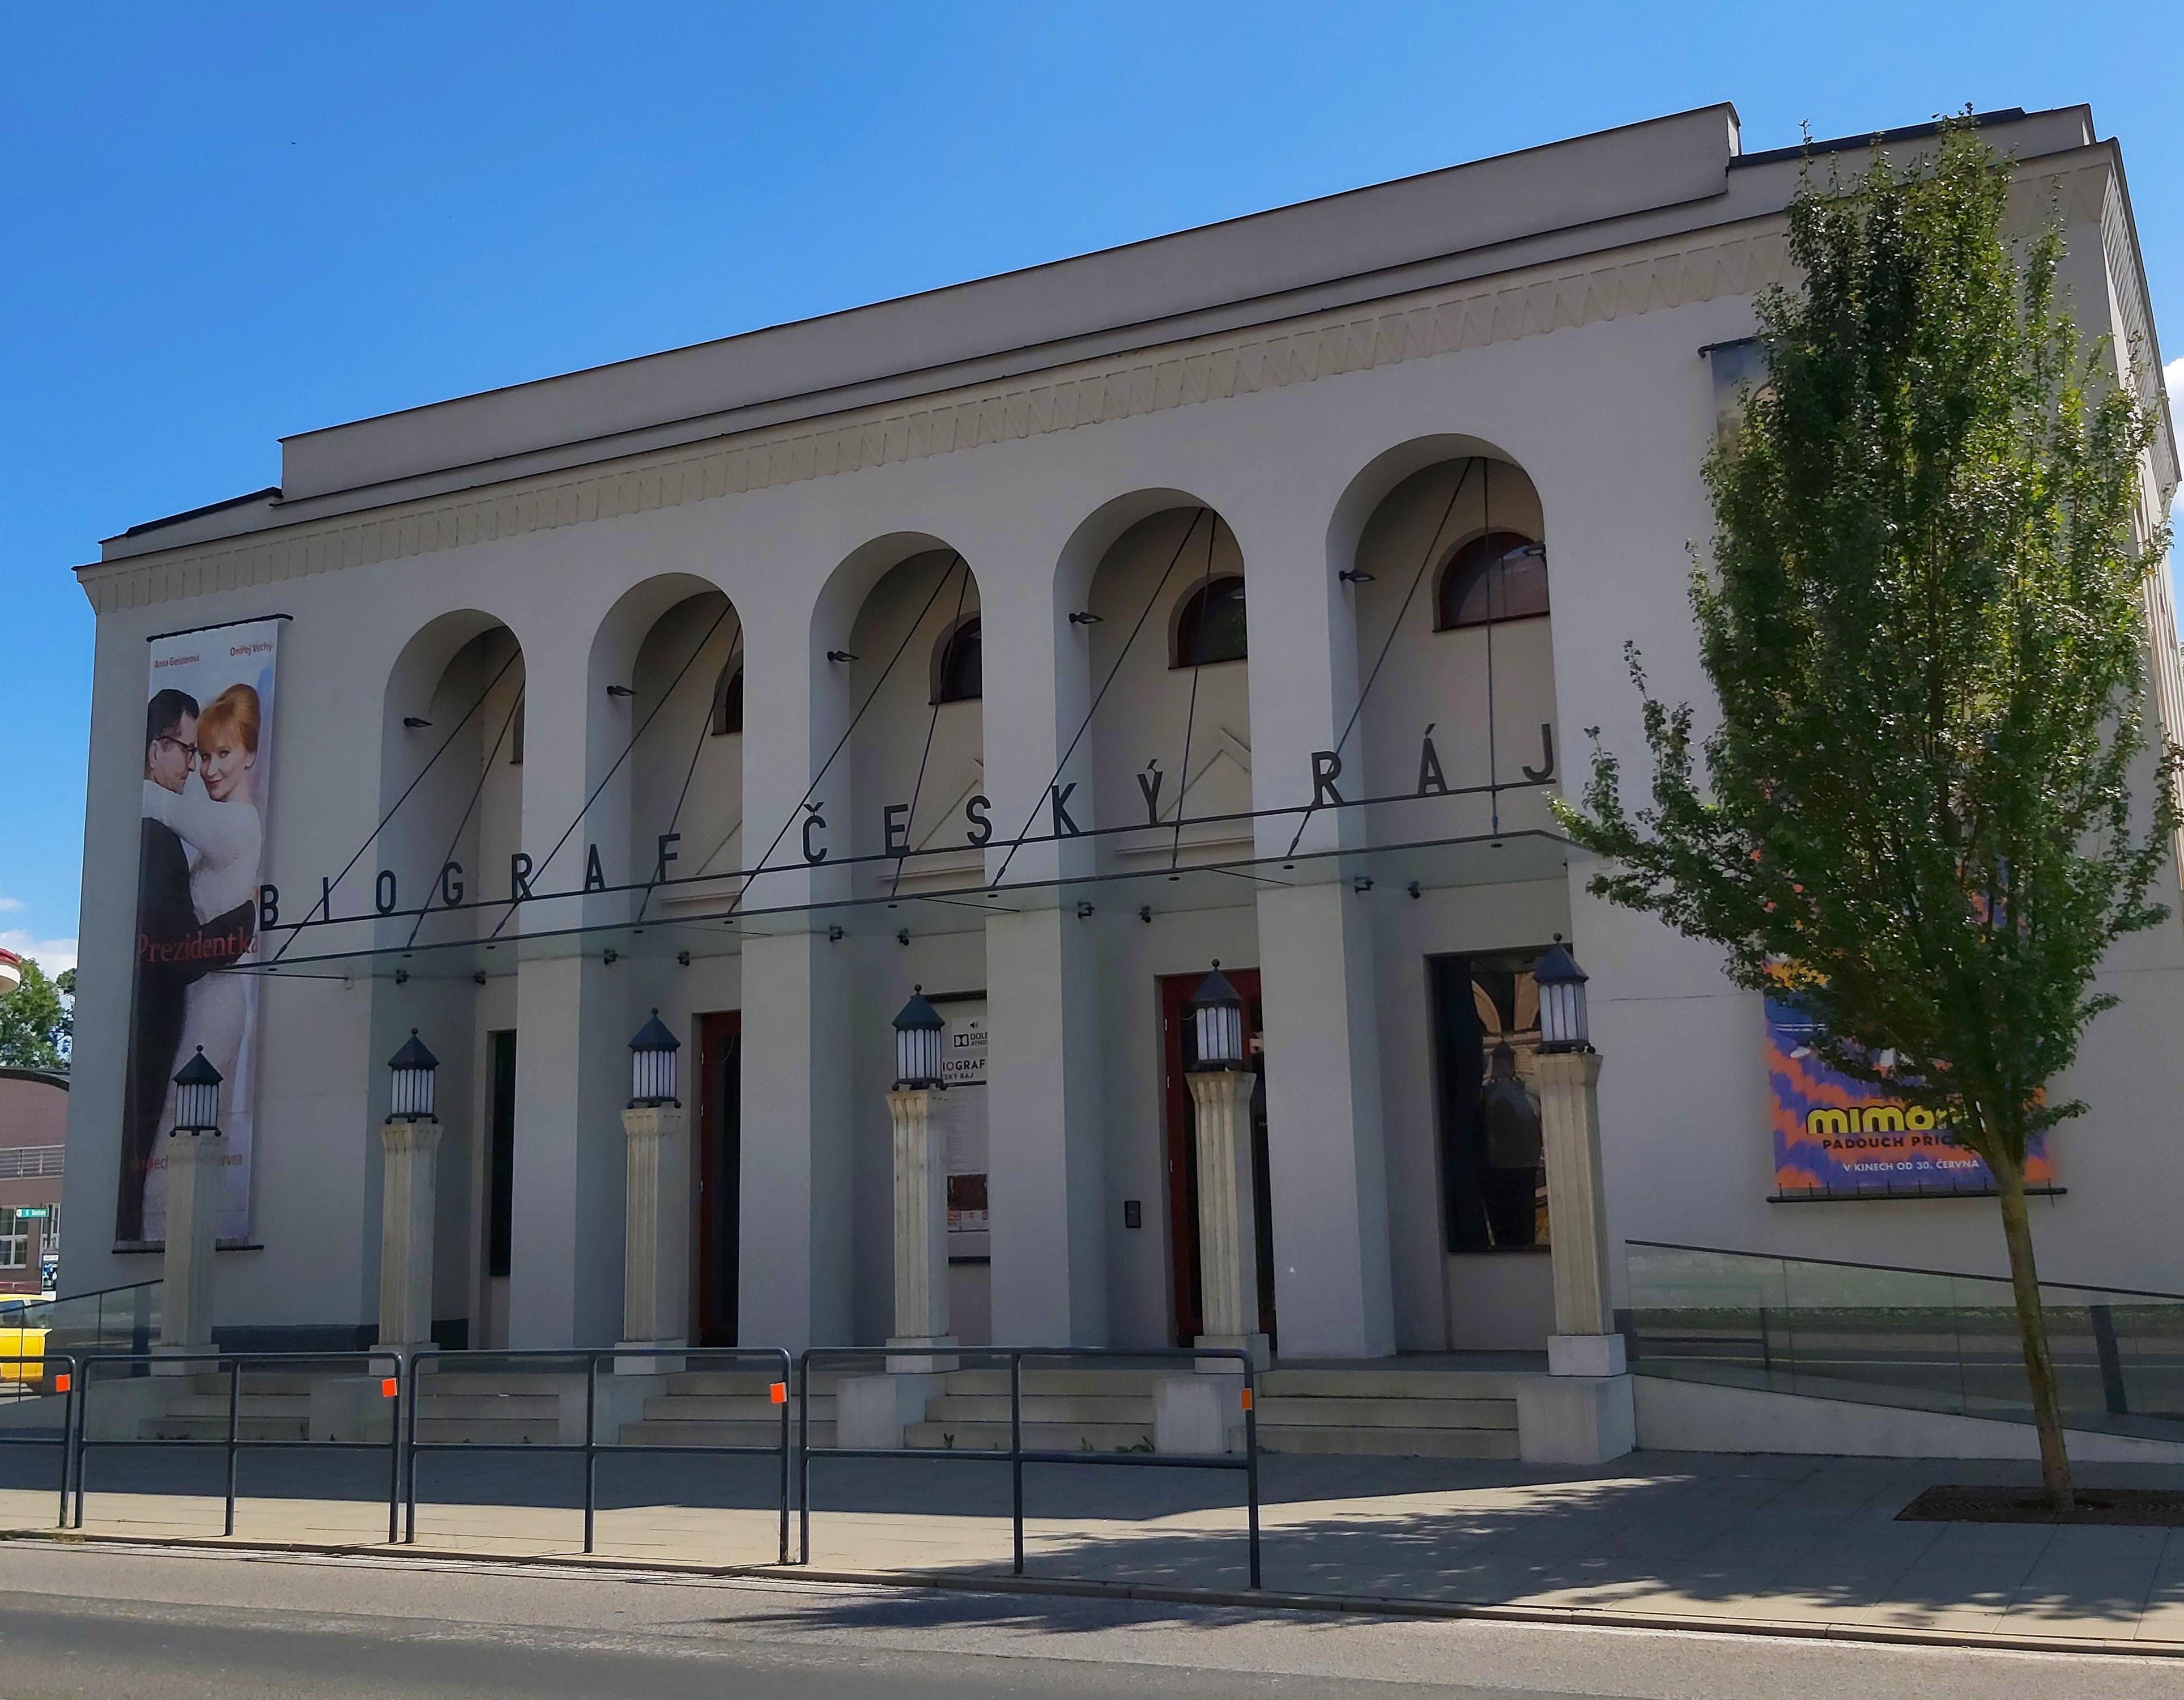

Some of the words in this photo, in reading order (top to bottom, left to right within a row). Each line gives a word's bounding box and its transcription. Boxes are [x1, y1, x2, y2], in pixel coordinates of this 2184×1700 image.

[260, 834, 680, 930] BIOGRAF
[802, 759, 1163, 863] ČESKÝ
[1311, 723, 1554, 808] RÁJ
[138, 926, 259, 962] Prezidentka
[943, 1059, 985, 1072] IOGRAF
[1823, 1136, 1904, 1149] PADOUCH
[1854, 1162, 1893, 1172] KINECH
[1897, 1162, 1913, 1170] OD
[1917, 1161, 1933, 1170] 30.
[1936, 1158, 1980, 1169] ČERVNA
